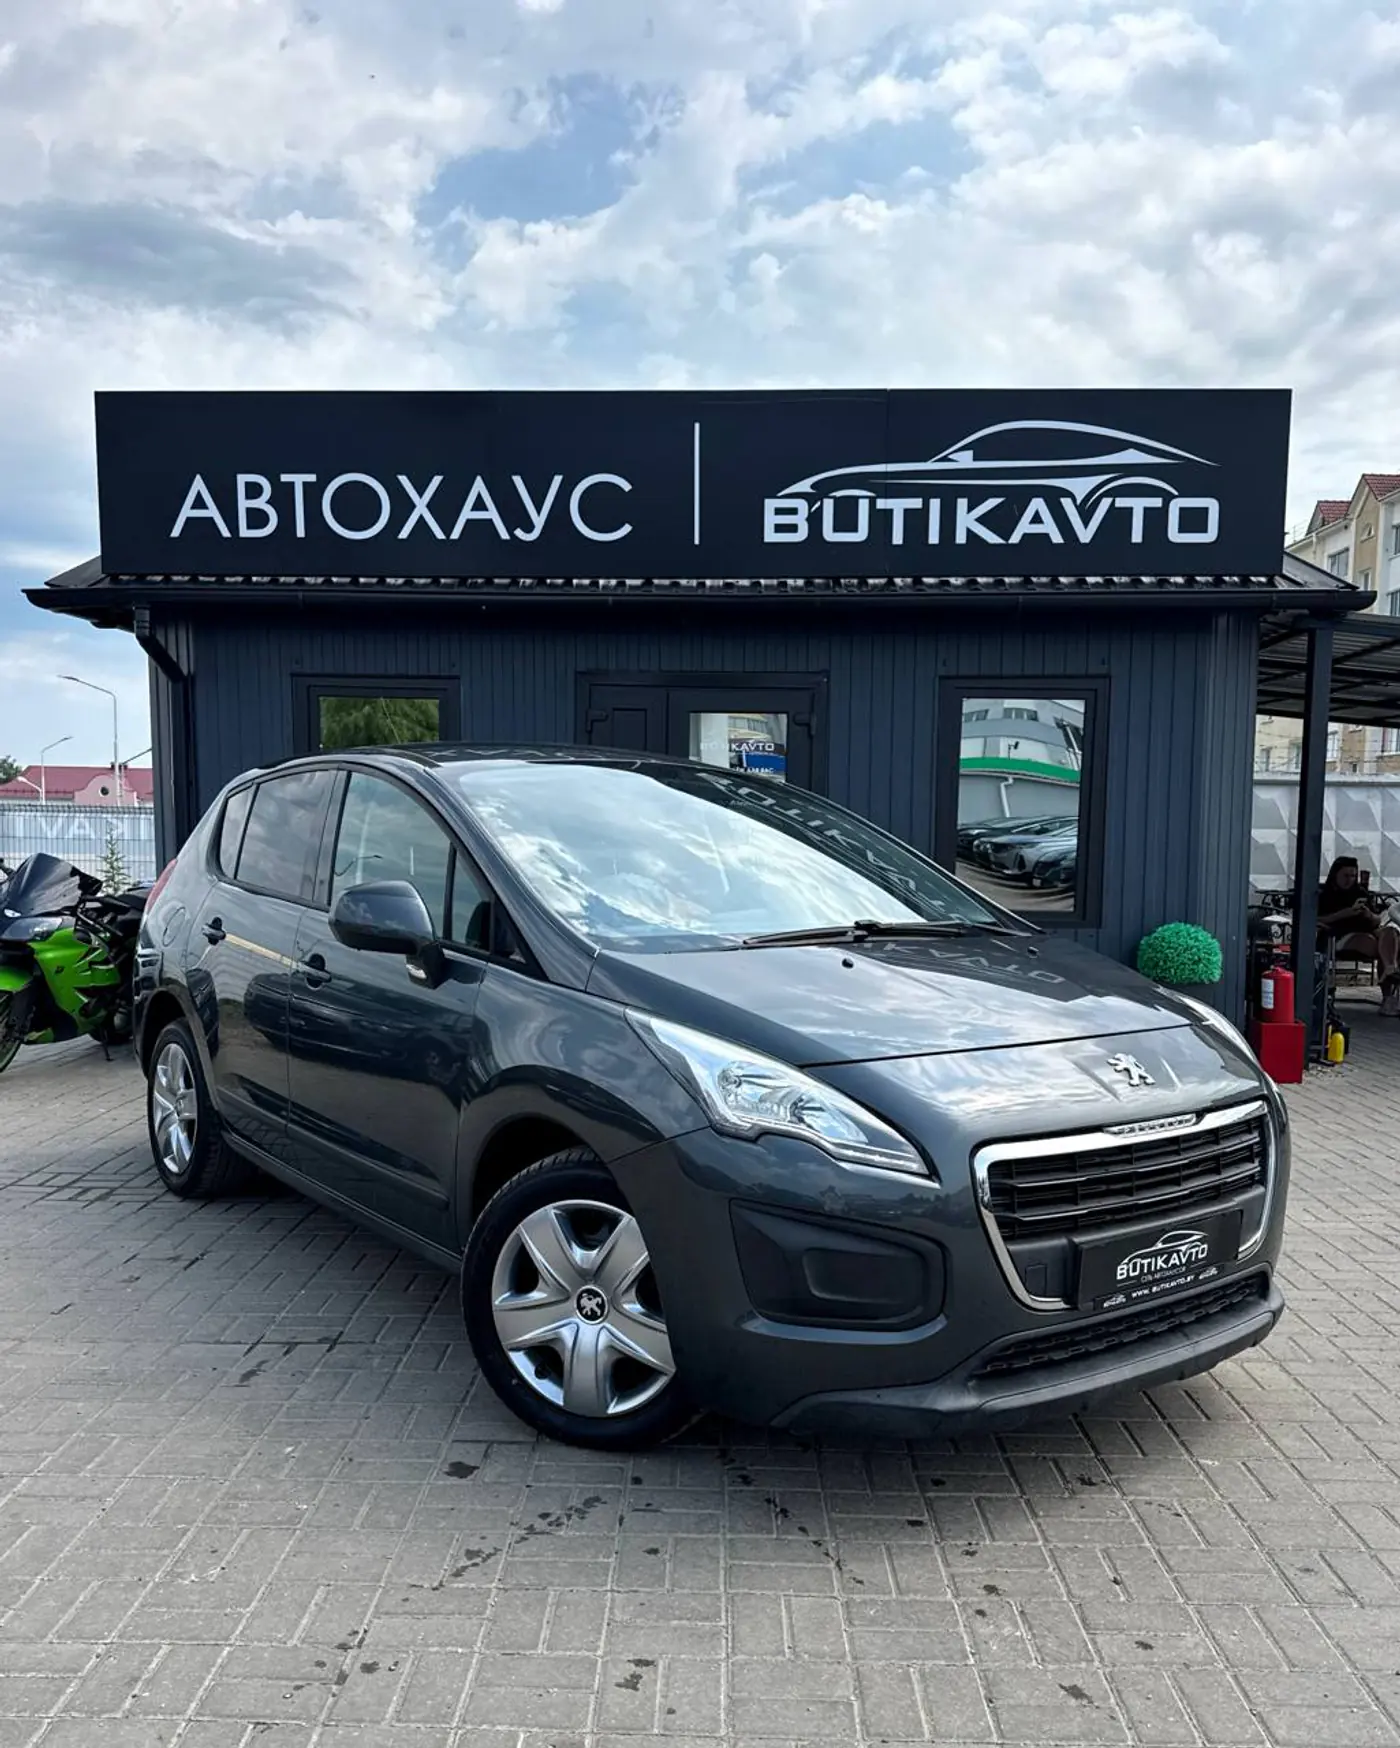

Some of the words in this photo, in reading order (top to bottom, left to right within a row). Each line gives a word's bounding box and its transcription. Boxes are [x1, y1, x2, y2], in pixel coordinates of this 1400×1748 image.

[170, 473, 634, 542] АВТОХАУС
[763, 495, 1220, 545] BUTIKAVTO
[1116, 1243, 1209, 1280] BUTIKAVTO
